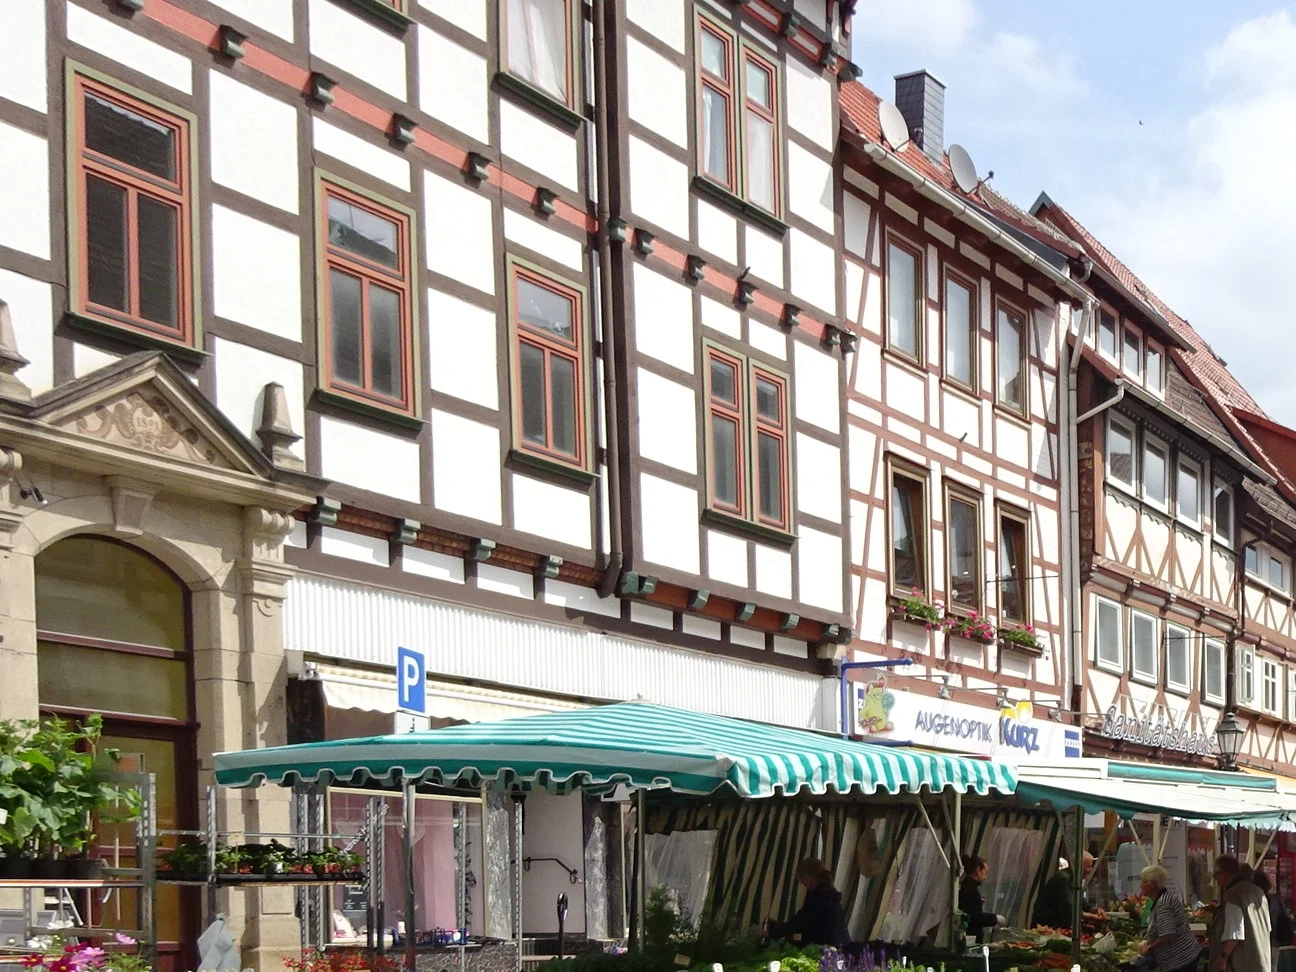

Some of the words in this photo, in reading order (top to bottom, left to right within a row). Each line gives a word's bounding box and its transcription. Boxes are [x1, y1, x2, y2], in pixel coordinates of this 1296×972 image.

[403, 655, 420, 703] P
[915, 710, 993, 742] AUGENOPTIK
[1101, 704, 1216, 756] Sanitätshaus
